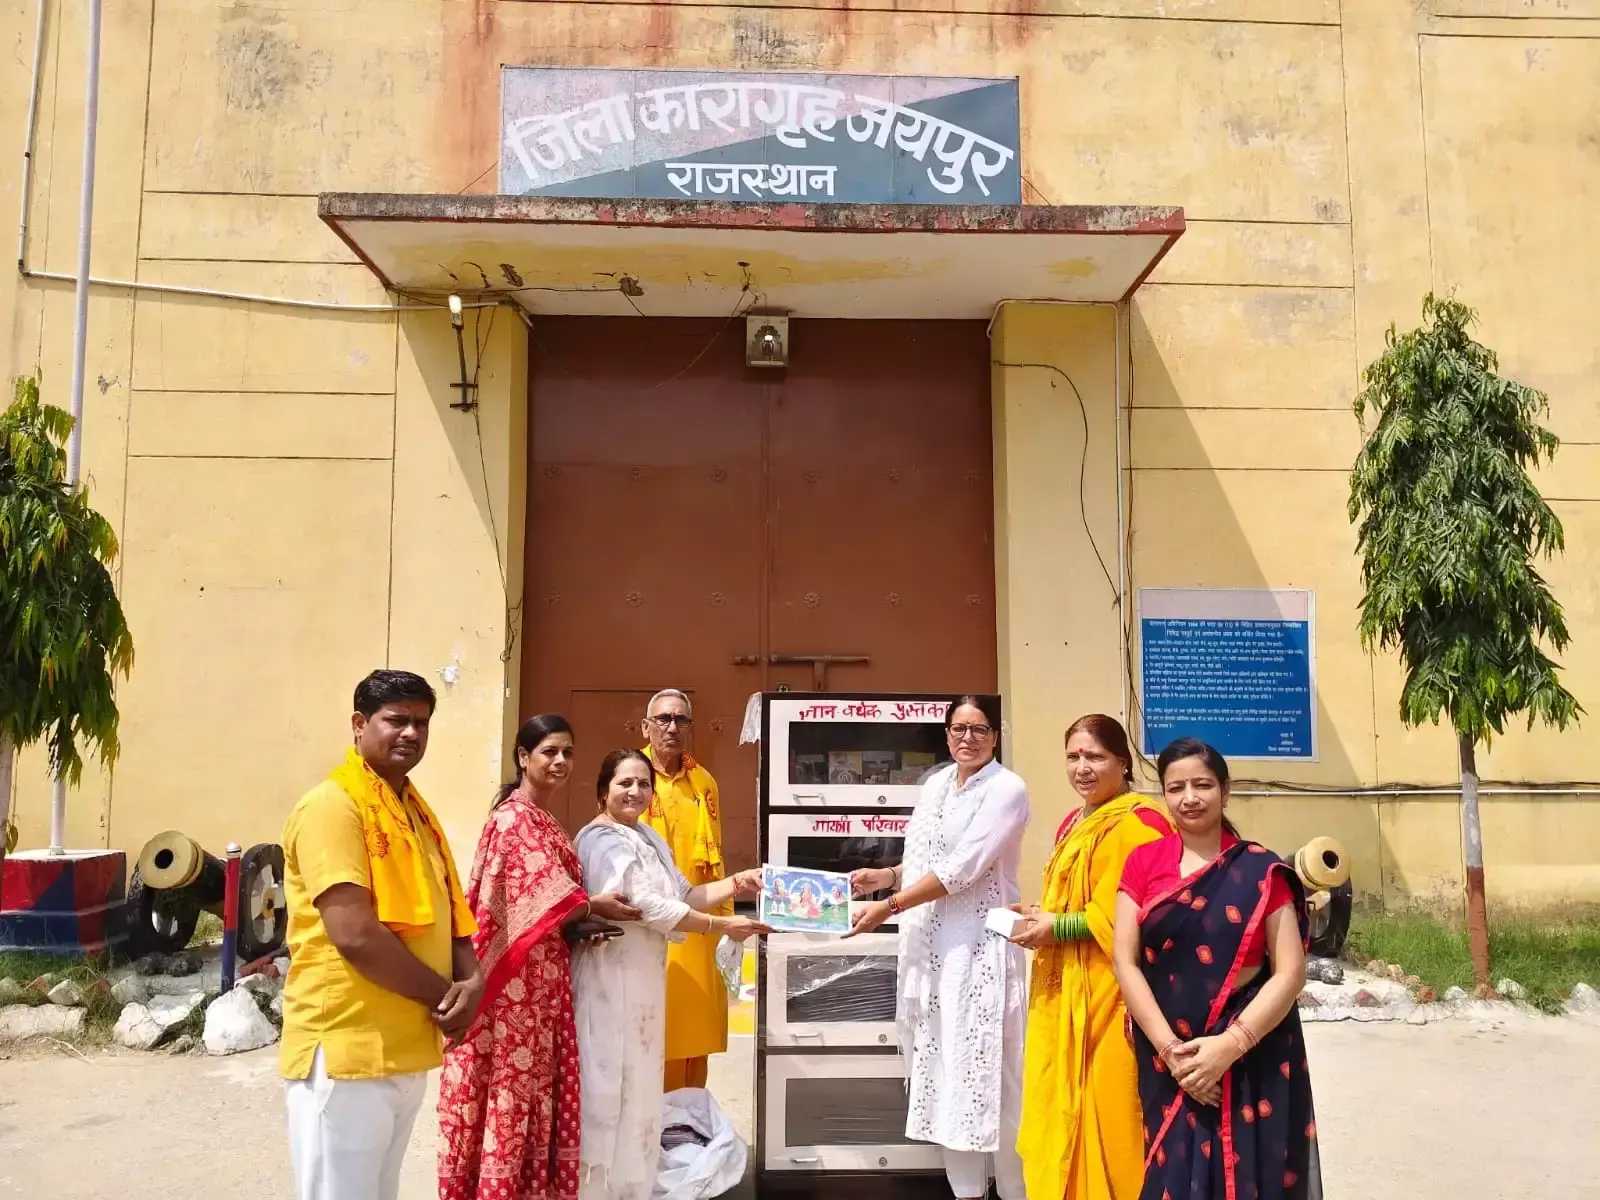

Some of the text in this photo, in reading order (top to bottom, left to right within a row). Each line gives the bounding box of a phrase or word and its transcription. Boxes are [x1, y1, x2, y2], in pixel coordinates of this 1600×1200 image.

[504, 82, 1014, 196] जिला कारागृह जयपुर
[664, 162, 838, 198] राजस्थान
[861, 814, 910, 834] परिवार
